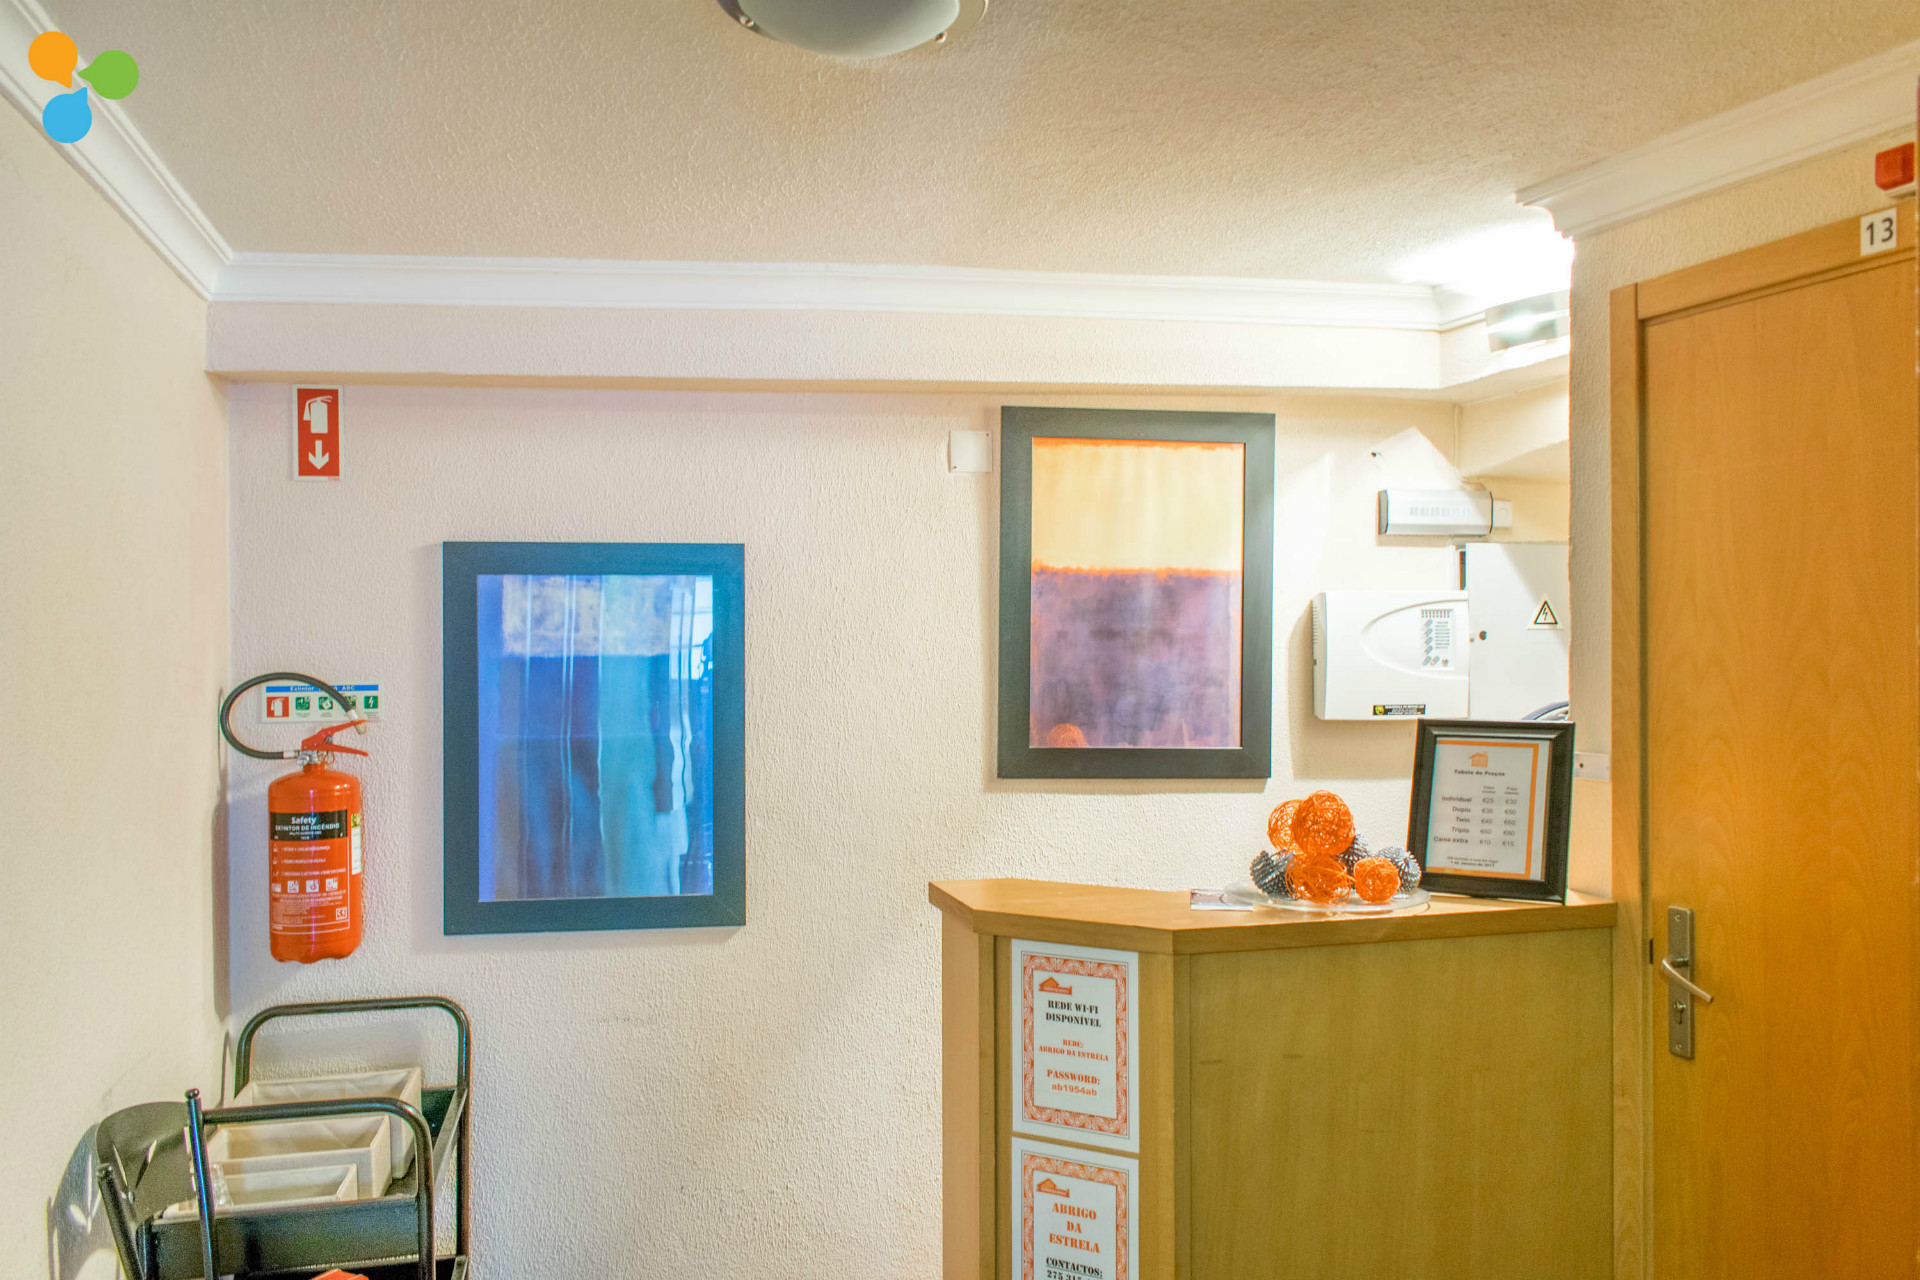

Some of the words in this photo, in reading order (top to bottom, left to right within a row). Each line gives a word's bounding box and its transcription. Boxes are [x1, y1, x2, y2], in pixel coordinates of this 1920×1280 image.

[1866, 217, 1894, 246] 13
[291, 816, 318, 826] Safety
[310, 822, 340, 831] INCÊNDIO
[1047, 1000, 1073, 1011] REDE
[1074, 1003, 1099, 1014] WI-FI
[1045, 1012, 1102, 1028] DISPONÍVEL
[1062, 1039, 1084, 1049] REDE:
[1038, 1045, 1065, 1055] ABRIGO
[1066, 1048, 1076, 1057] DA
[1077, 1050, 1109, 1062] ESTRELA
[1046, 1069, 1101, 1086] PASSWORD:
[1051, 1084, 1098, 1097] ab1954ab
[1052, 1202, 1097, 1220] ABRIGO
[1066, 1221, 1082, 1234] DA
[1049, 1233, 1100, 1254] ESTRELA
[1045, 1256, 1103, 1278] CONTACTOS:
